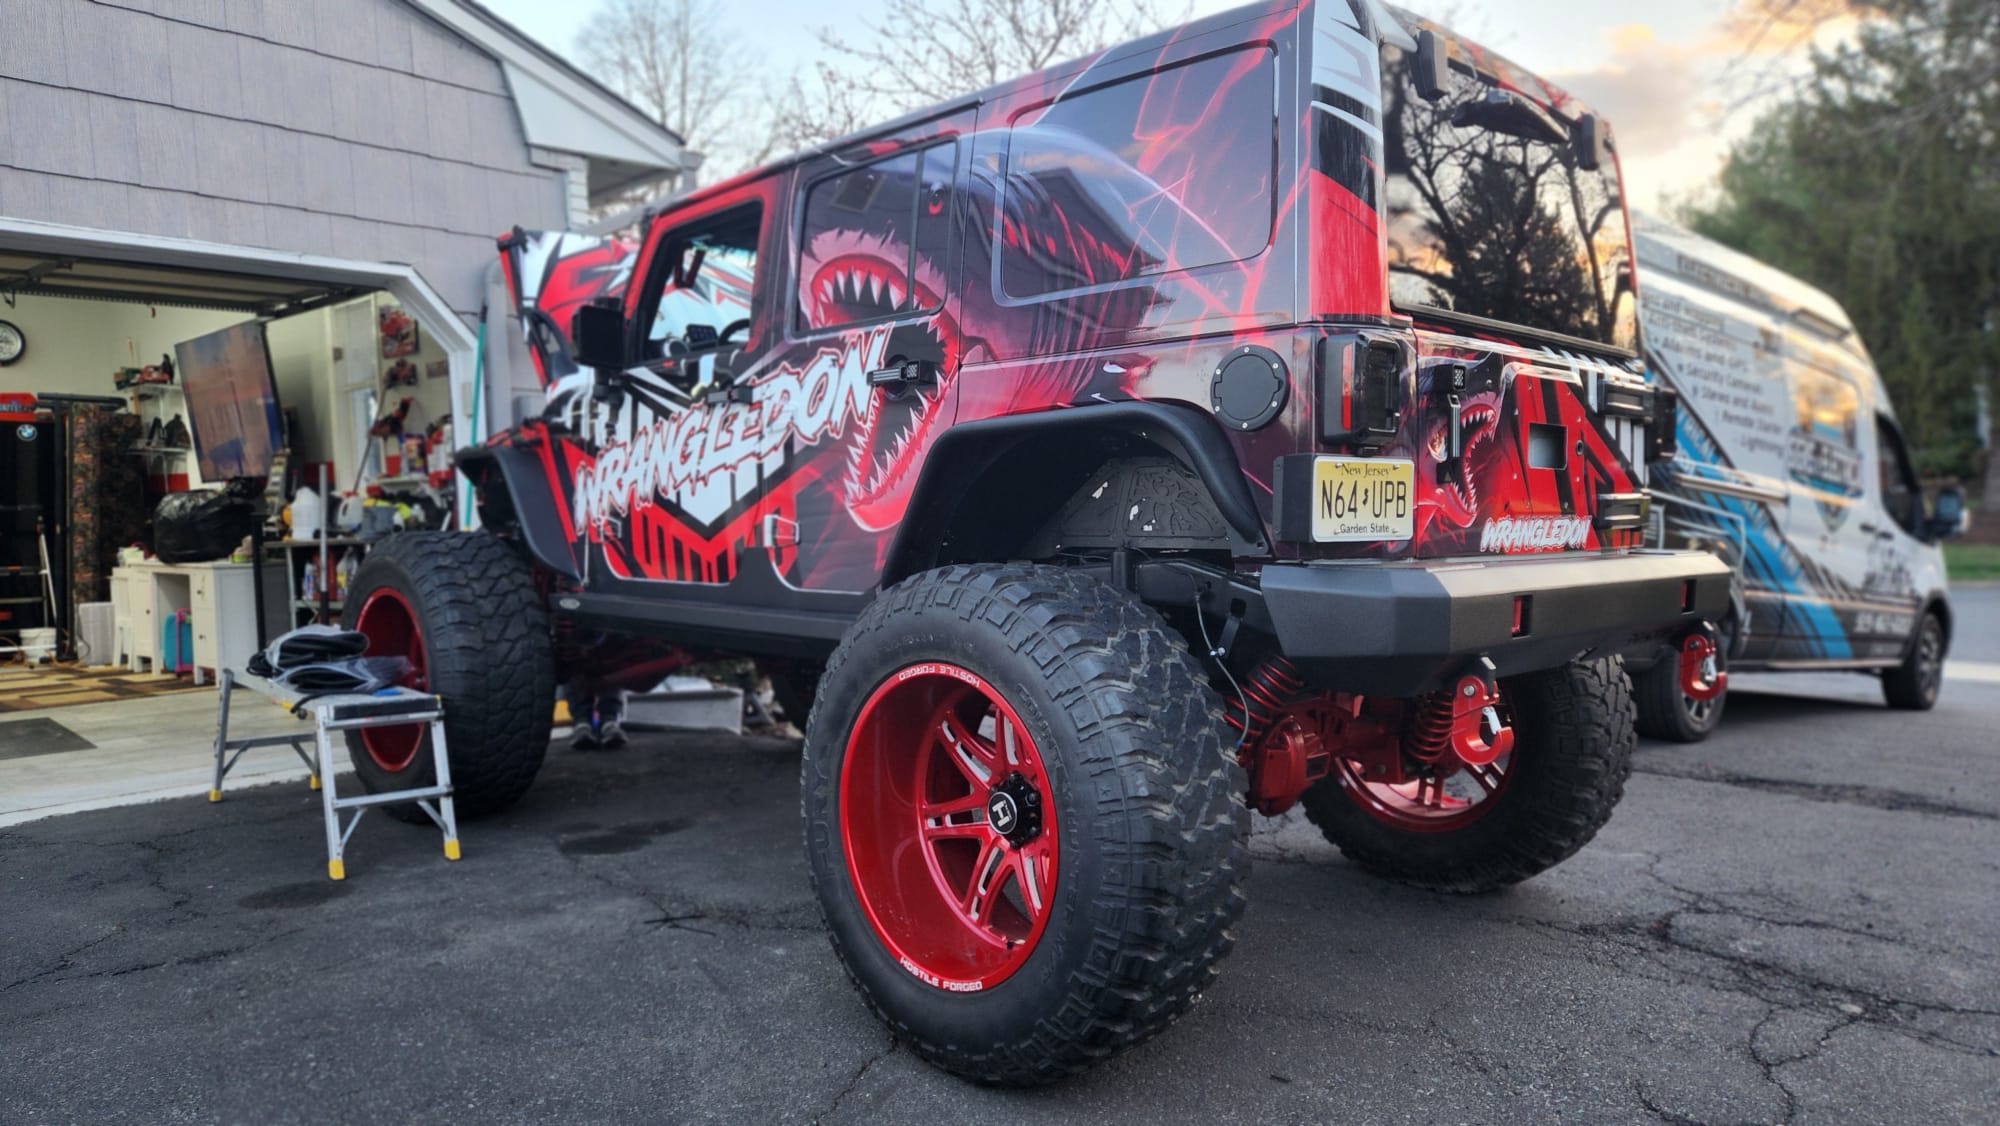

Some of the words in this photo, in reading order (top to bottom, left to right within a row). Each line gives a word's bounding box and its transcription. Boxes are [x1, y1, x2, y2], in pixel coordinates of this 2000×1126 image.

[575, 321, 894, 534] WRANGLEDON
[1341, 463, 1361, 476] New
[1364, 463, 1389, 478] Jersey
[1321, 479, 1358, 519] N64
[1372, 479, 1407, 519] UPB
[1340, 523, 1368, 534] Garden
[1370, 522, 1389, 534] State
[1479, 514, 1593, 554] WRANGLEDON
[939, 665, 980, 688] HOSTILE
[900, 956, 939, 987] HOSTILE
[943, 980, 983, 992] FORGED
